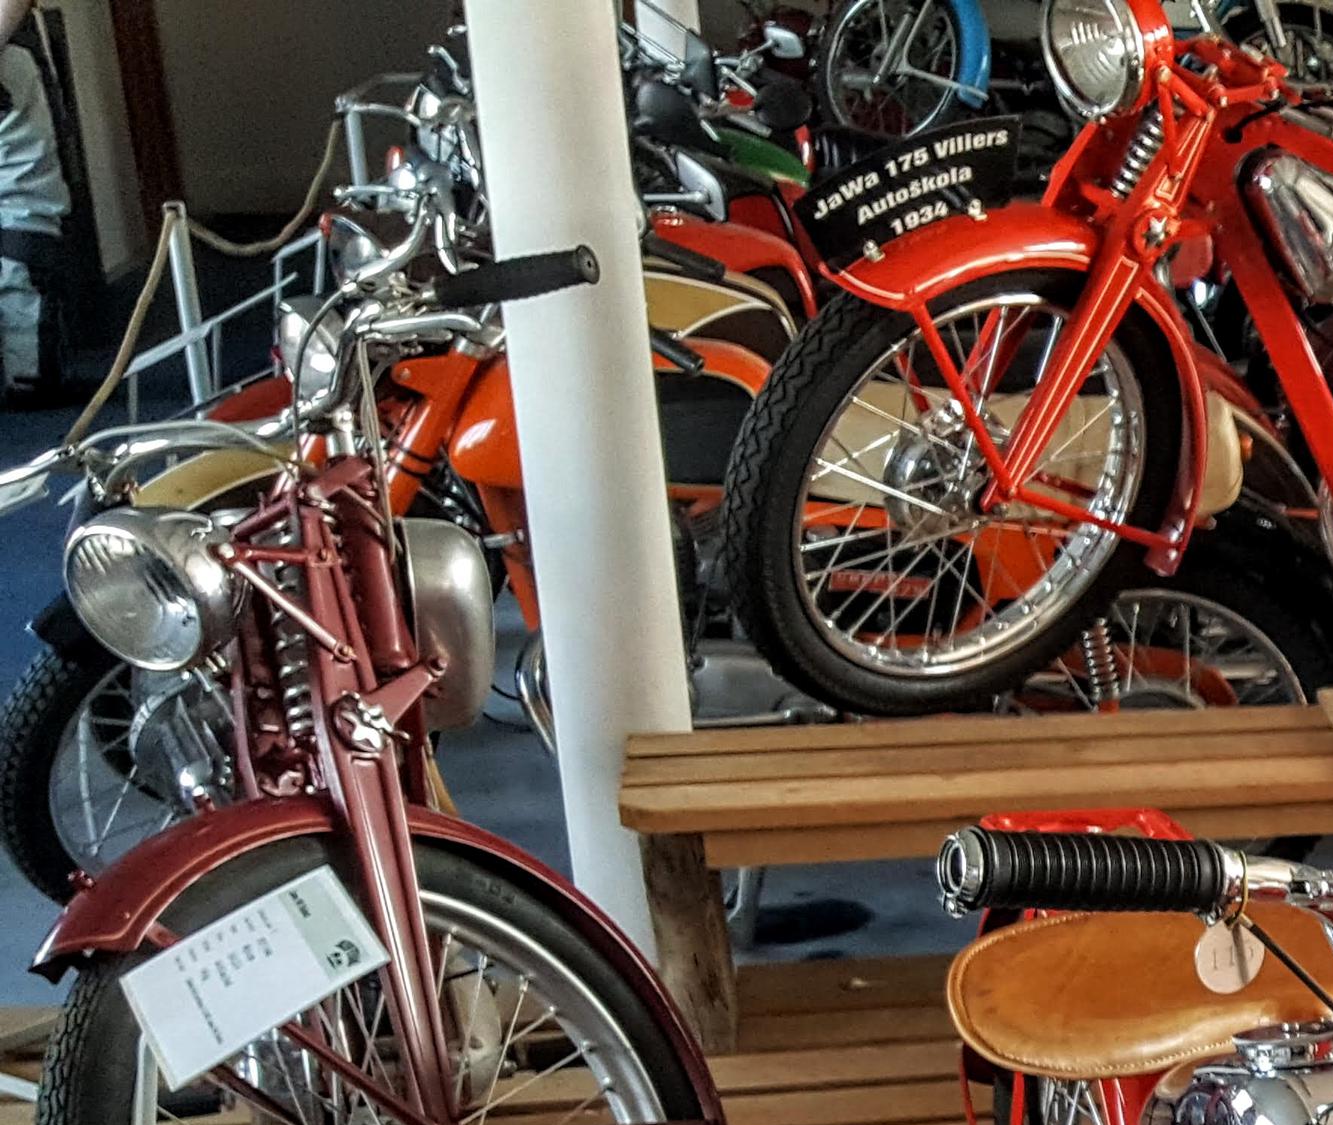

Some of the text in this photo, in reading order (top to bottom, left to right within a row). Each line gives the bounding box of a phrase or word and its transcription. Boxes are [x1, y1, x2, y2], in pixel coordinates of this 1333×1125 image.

[814, 129, 1009, 220] JaWa 175 Villers
[857, 165, 973, 225] Autoškola
[890, 201, 949, 236] 1934
